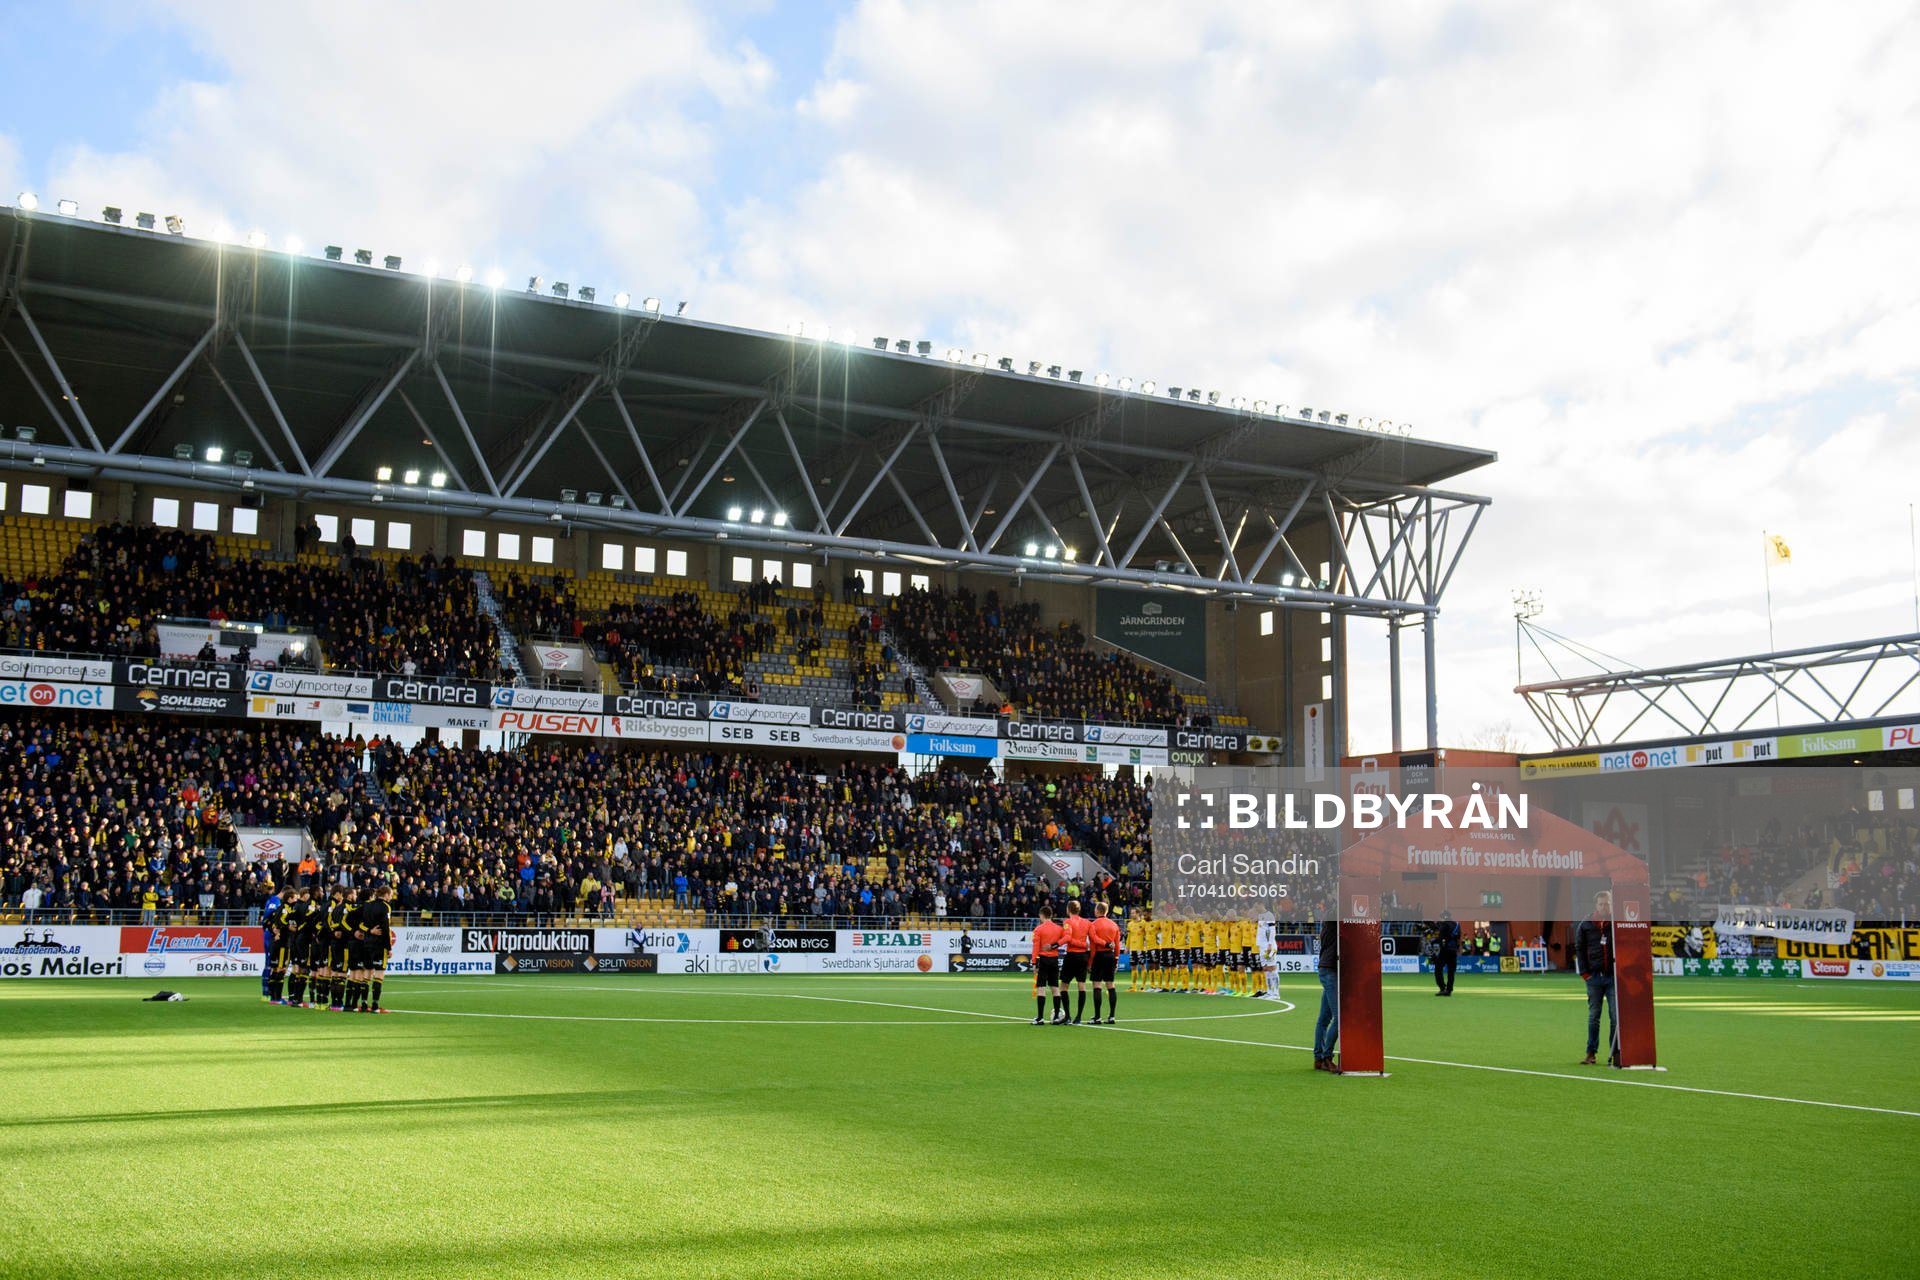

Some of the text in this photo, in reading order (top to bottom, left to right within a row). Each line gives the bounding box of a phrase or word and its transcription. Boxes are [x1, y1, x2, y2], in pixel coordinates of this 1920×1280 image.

[1120, 615, 1185, 625] JÄRNGRINDEN
[128, 664, 230, 688] Cernera
[387, 680, 476, 704] Cernera
[160, 695, 227, 708] SOHLBERG
[374, 702, 412, 713] ALWAYS
[616, 696, 697, 717] Cernera
[448, 718, 475, 727] MAKE
[498, 712, 599, 734] PULSEN
[821, 709, 895, 729] Cernera
[625, 719, 704, 737] Riksbyggen
[722, 727, 800, 742] SEB SEB
[1007, 721, 1074, 740] Cernera
[812, 733, 890, 747] Swedbank Sjuhärad
[929, 738, 976, 754] Folksam
[1176, 732, 1238, 750] Cernera
[1801, 736, 1856, 753] Folksam
[1006, 741, 1078, 757] Borås Tidning
[1171, 752, 1205, 766] onyx
[1406, 777, 1429, 785] BADRUM
[1407, 846, 1584, 870] Framåt för svensk fotboll!
[1834, 918, 1847, 933] ER
[406, 931, 455, 941] Vi installerar
[467, 930, 589, 954] Skyltproduktion
[801, 938, 829, 948] BYGG
[862, 933, 921, 946] PEAB
[406, 944, 453, 954] allt vi säljer
[40, 956, 122, 976] Måleri
[196, 961, 258, 972] BORÅS BIL
[386, 958, 492, 974] raftsByggarna
[518, 958, 574, 968] SPLITVISION
[599, 958, 652, 968] SPLITVISION
[684, 953, 760, 973] aki travel
[822, 957, 915, 970] Swedbank Sjuhärad
[966, 958, 1010, 967] SOHLBERG
